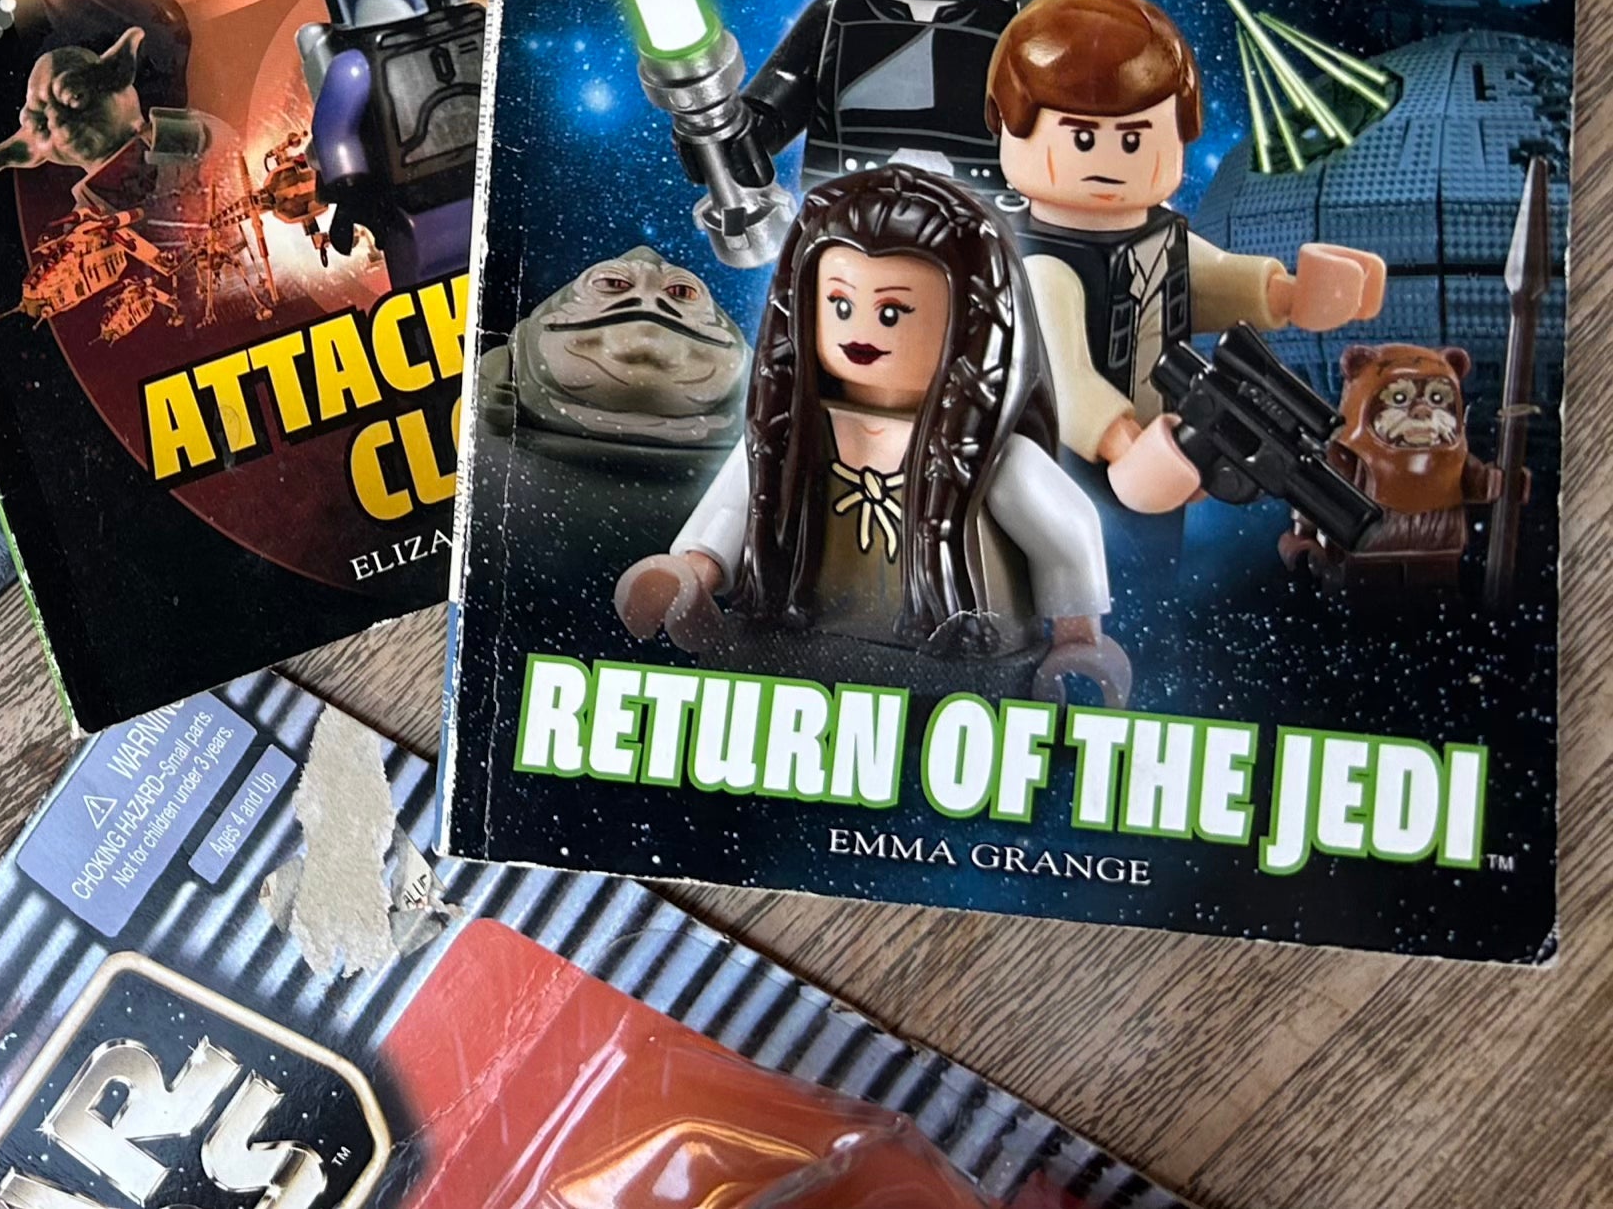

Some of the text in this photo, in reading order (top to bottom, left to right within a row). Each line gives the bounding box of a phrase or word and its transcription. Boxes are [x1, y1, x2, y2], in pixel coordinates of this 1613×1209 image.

[350, 395, 463, 521] CL
[71, 831, 126, 901] CHOKING
[185, 710, 214, 751] parts.
[111, 726, 235, 889] Not for children under 3 years.
[209, 771, 279, 859] Ages 4 and Up
[518, 658, 905, 805] RETURN
[926, 696, 1054, 819] OF
[1070, 709, 1257, 841] THE
[1262, 730, 1484, 871] JEDI
[828, 828, 1152, 886] EMMA GRANGE
